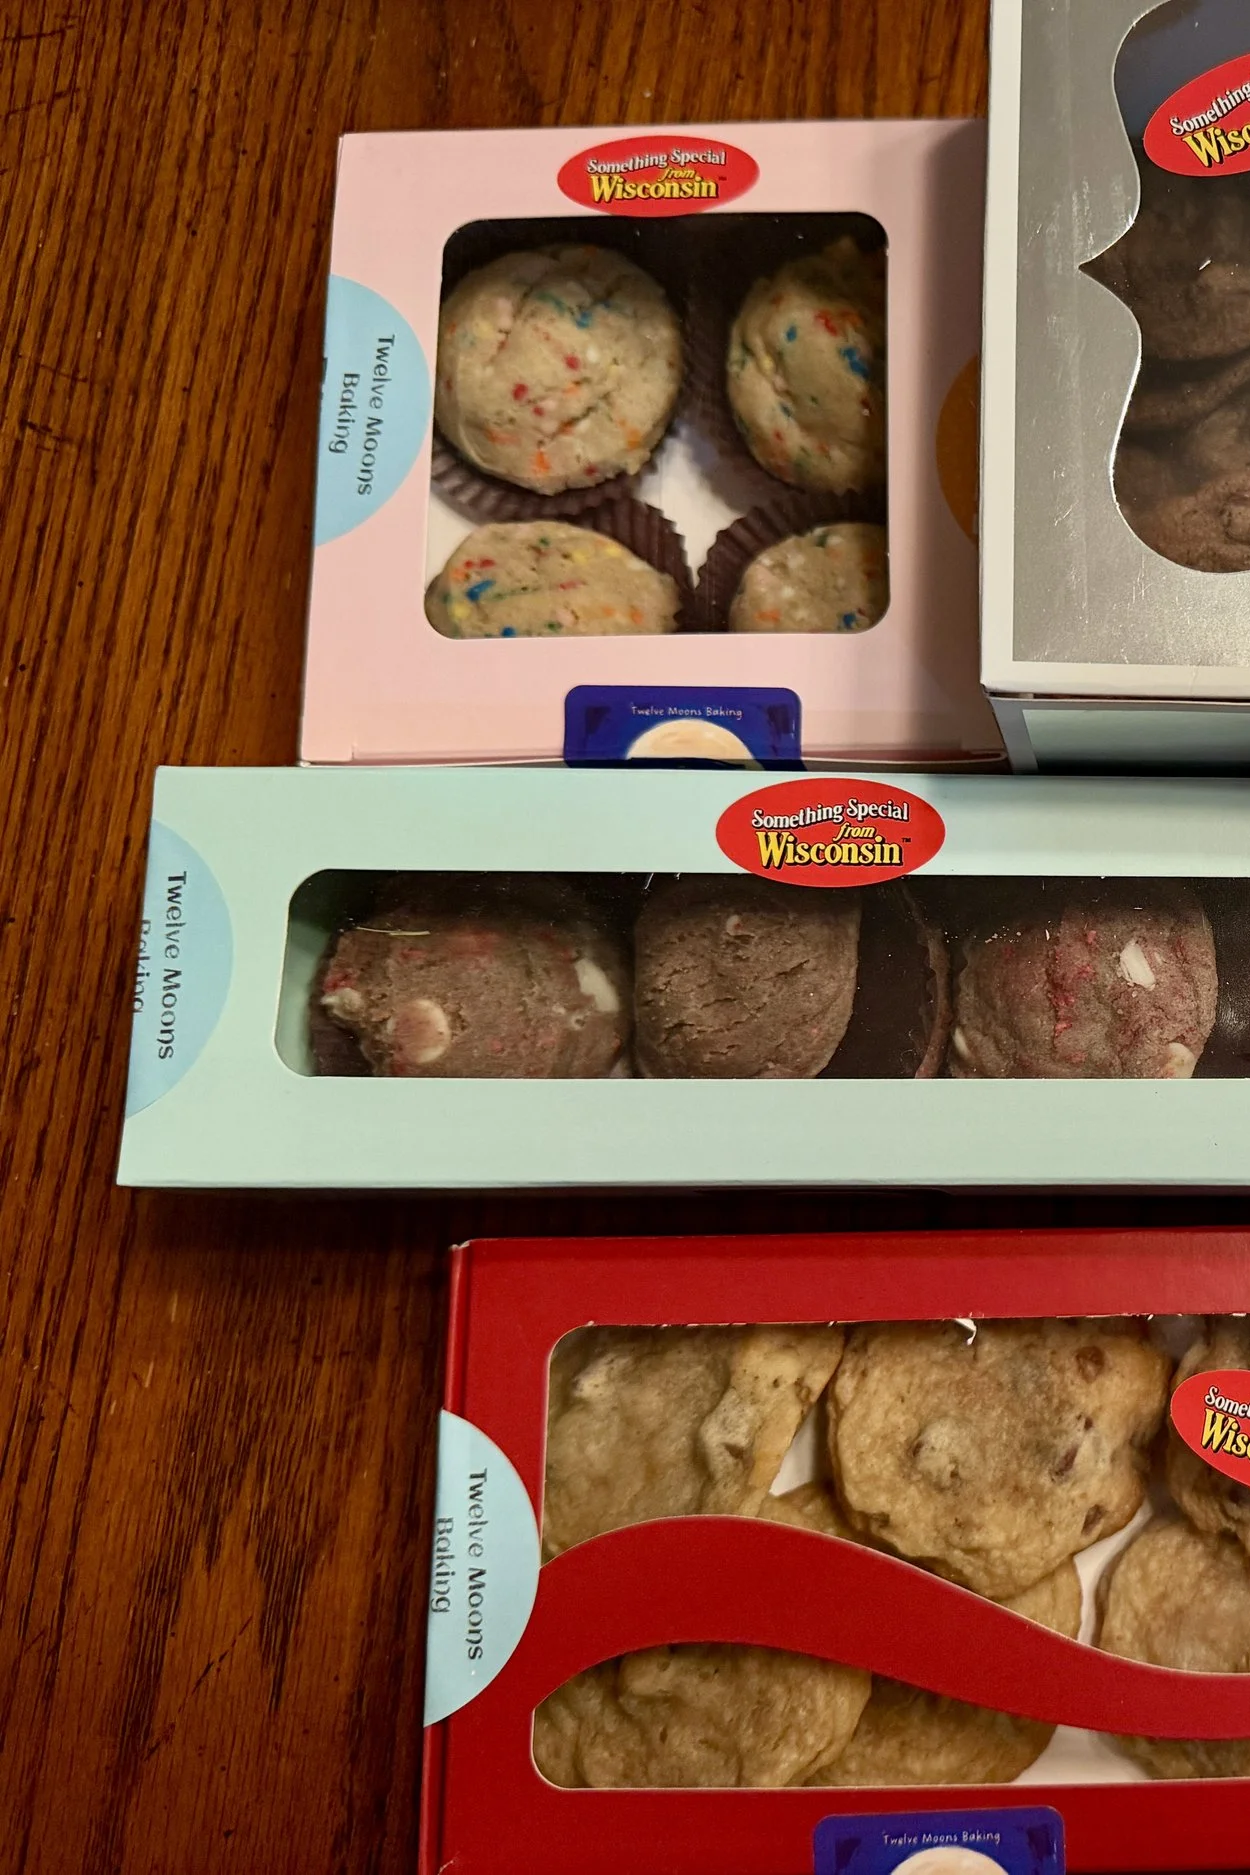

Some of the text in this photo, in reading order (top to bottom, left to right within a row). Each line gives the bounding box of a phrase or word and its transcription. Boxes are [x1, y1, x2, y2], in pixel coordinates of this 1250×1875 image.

[586, 148, 727, 174] Something Special
[658, 168, 696, 183] from
[589, 174, 719, 203] Wisconsin
[328, 372, 361, 454] Baking
[357, 333, 395, 496] Twelve Moons
[631, 705, 743, 721] Twelve Moons Baking
[751, 798, 909, 829] Something Special
[833, 822, 876, 841] from
[755, 831, 903, 869] Wisconsin
[158, 871, 187, 1060] Twelve Moons
[431, 1517, 456, 1614] Baking
[465, 1468, 488, 1661] Twelve Moons
[882, 1830, 1001, 1846] Twelve Moons Baking
